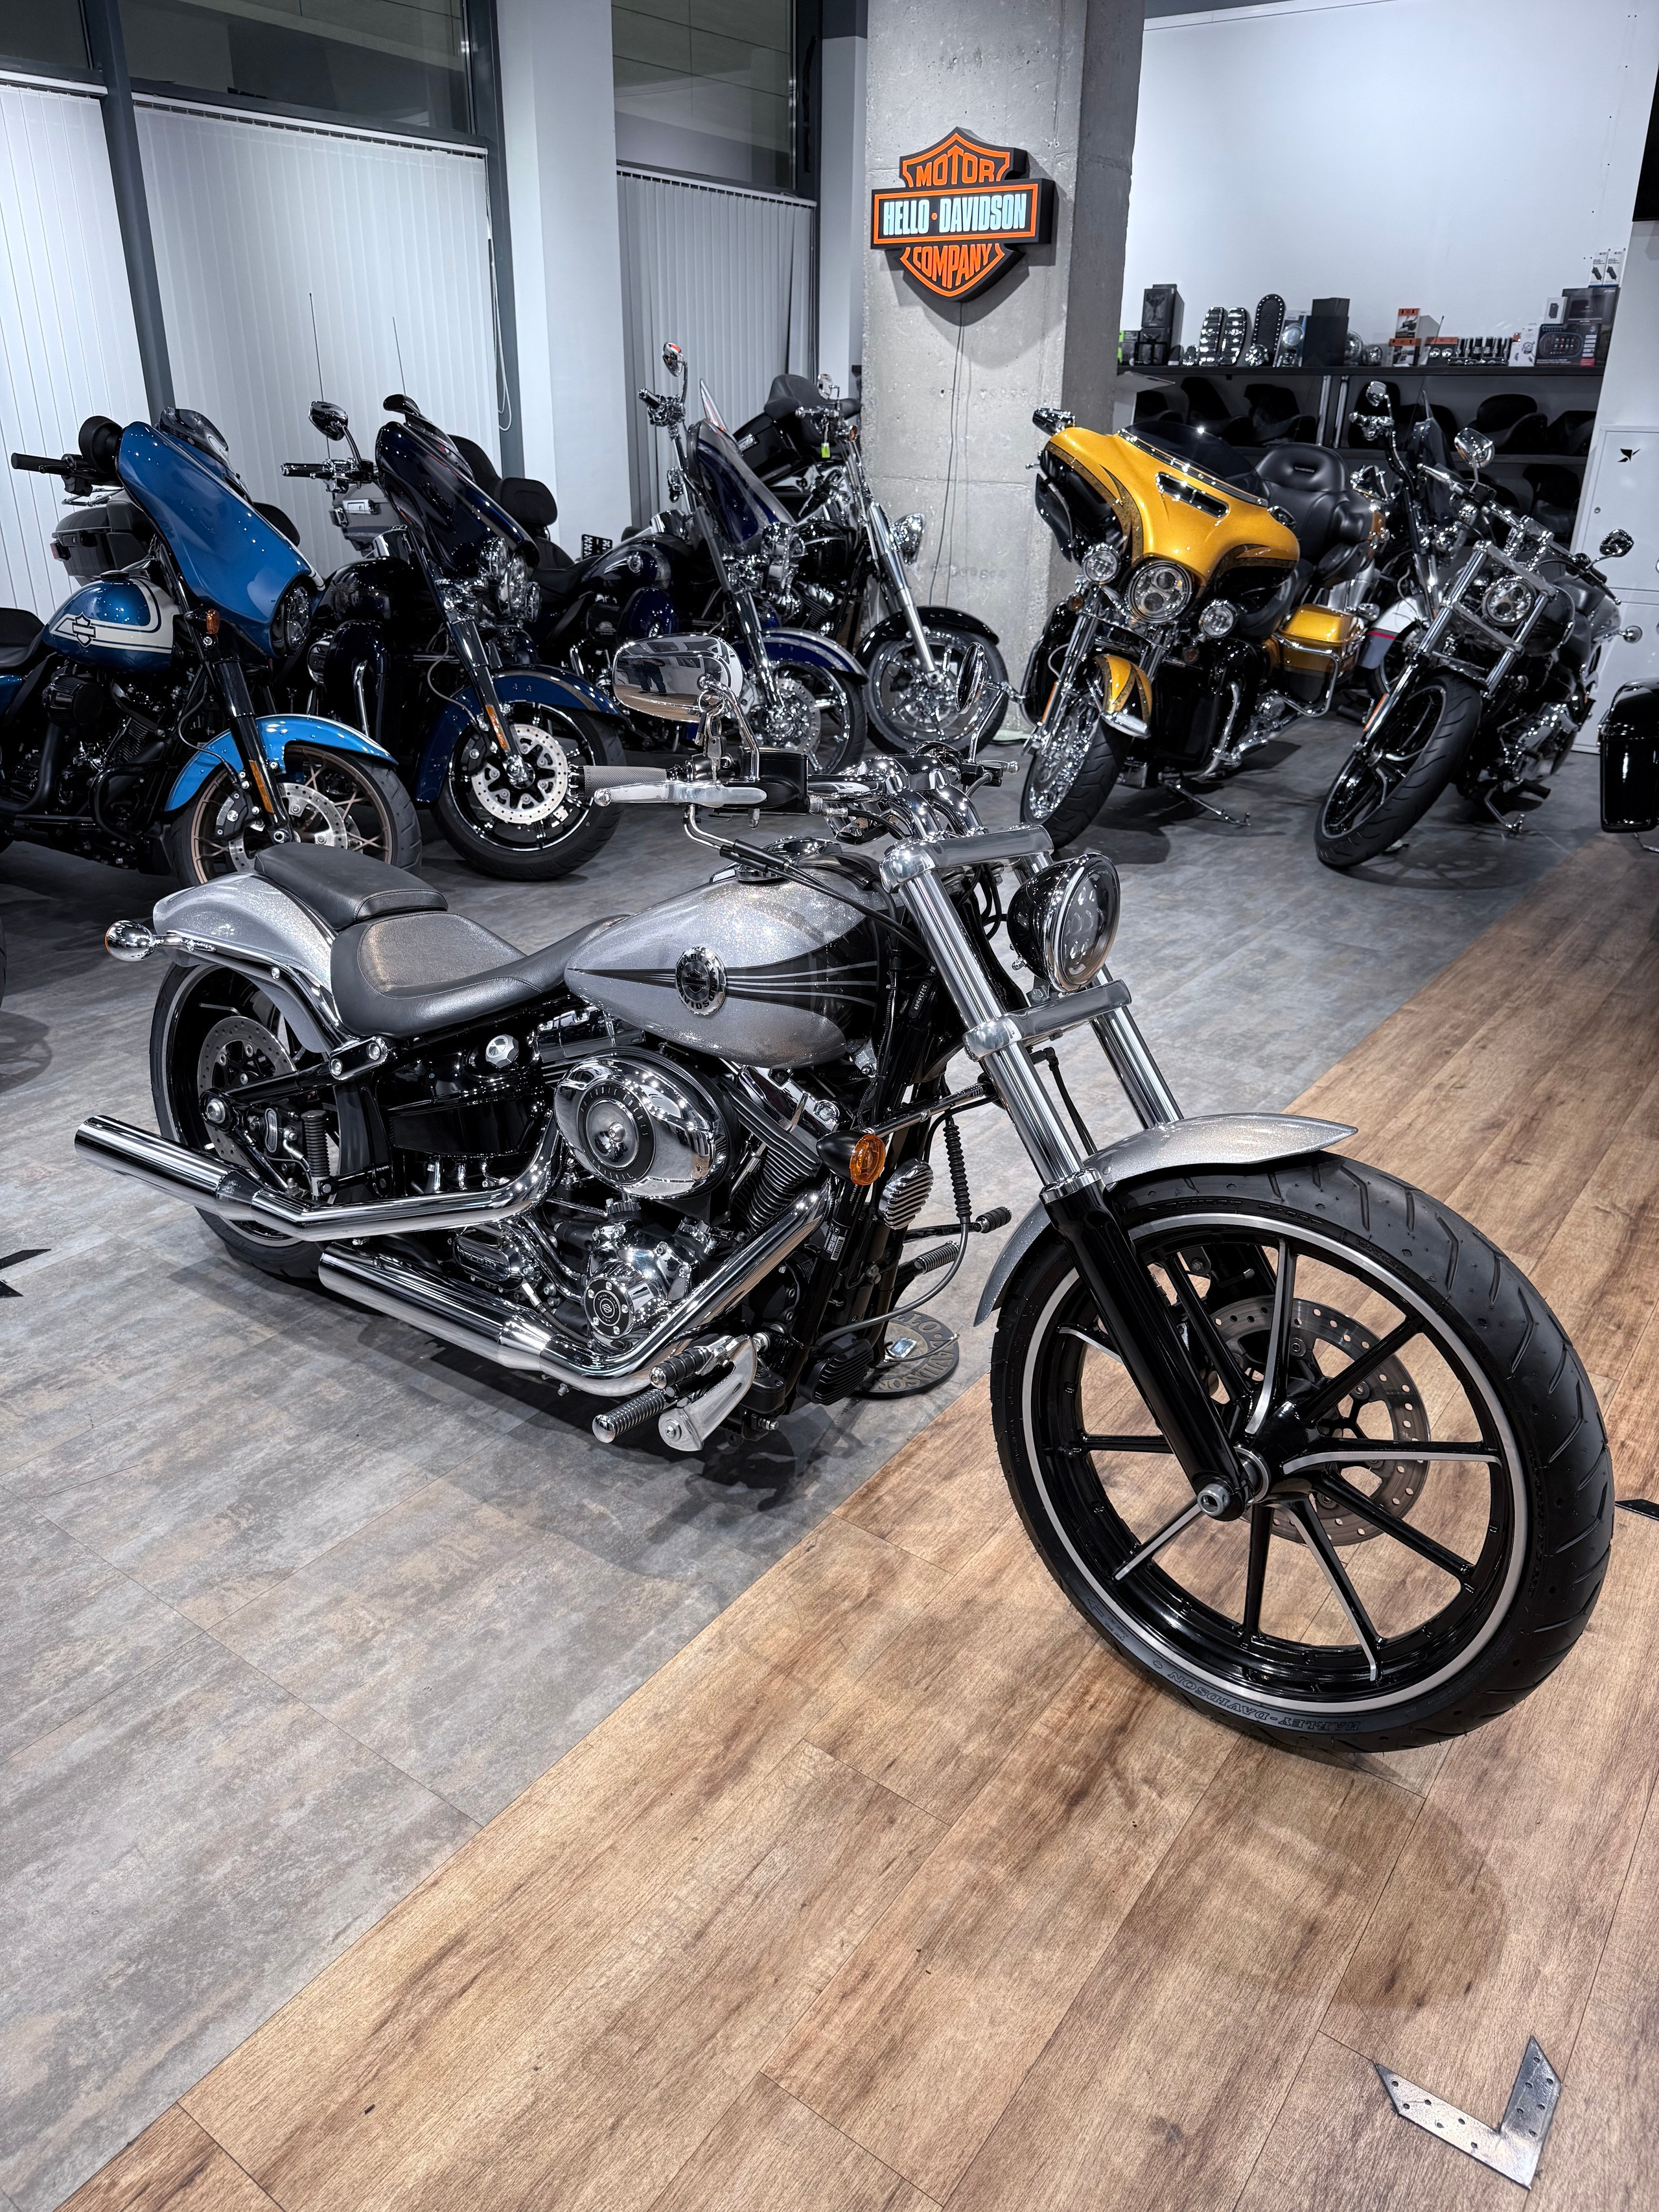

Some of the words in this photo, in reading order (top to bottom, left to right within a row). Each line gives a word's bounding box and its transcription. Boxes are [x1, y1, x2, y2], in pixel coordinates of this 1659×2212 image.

[916, 145, 995, 187] MOTOR
[883, 200, 930, 235] HELLO
[939, 193, 1027, 233] DAVIDSON
[912, 244, 992, 289] COMPANY
